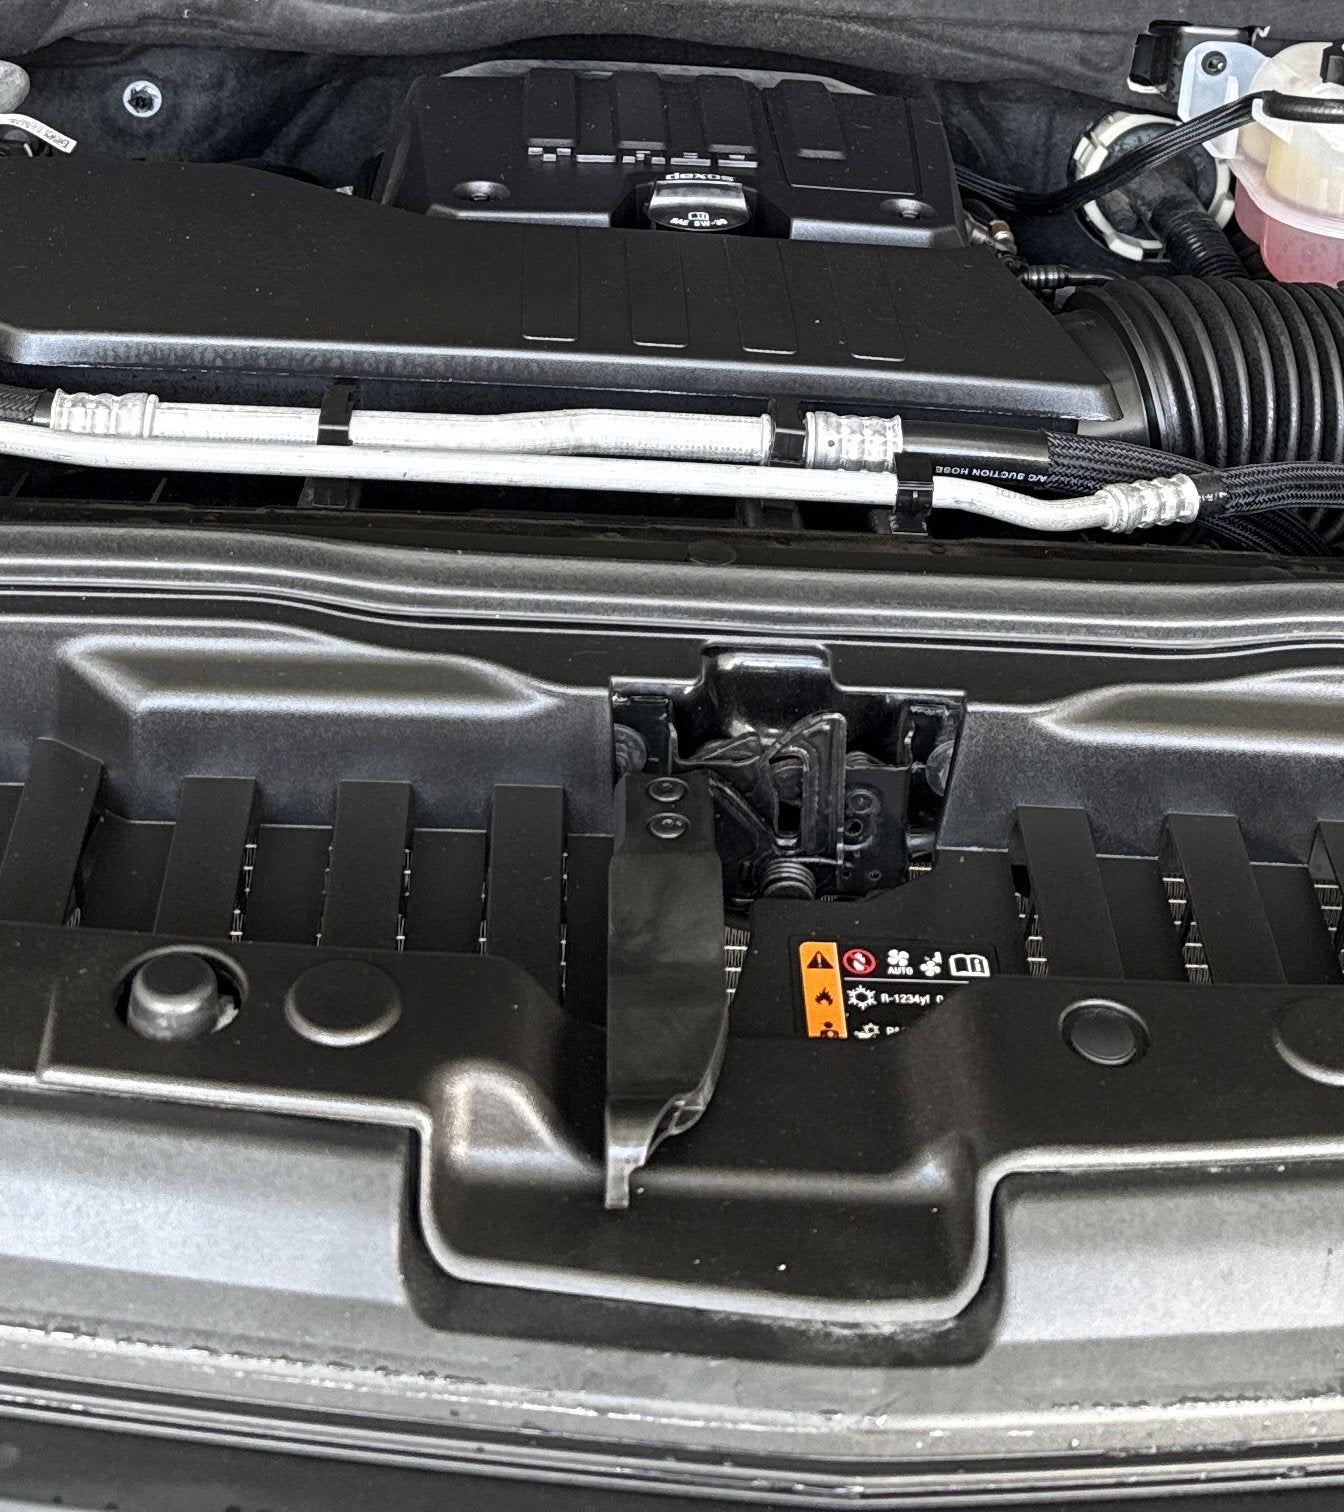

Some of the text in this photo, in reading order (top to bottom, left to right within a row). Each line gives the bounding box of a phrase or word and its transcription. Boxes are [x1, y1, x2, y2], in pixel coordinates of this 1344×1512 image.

[665, 172, 735, 182] dexos
[935, 465, 970, 476] HOSE
[972, 468, 1026, 481] SUCTION
[887, 966, 914, 976] AUTO
